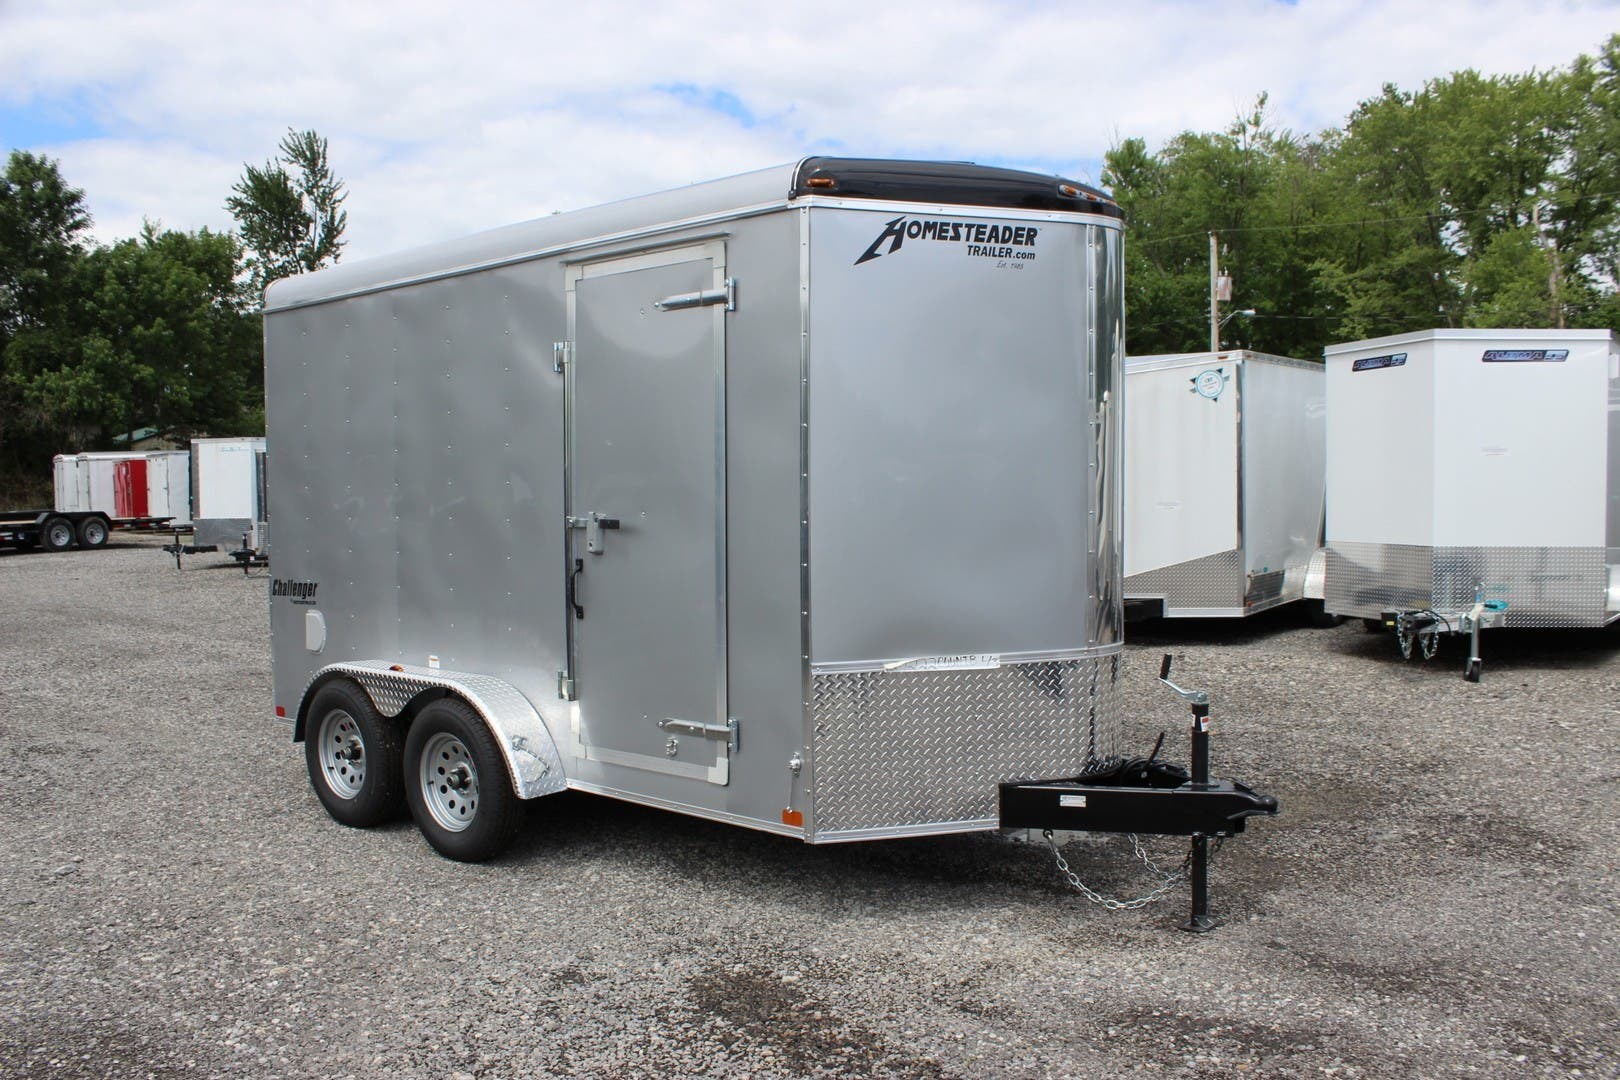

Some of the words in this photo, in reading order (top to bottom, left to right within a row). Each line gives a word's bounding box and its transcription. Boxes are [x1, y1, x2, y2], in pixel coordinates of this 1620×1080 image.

[854, 216, 1038, 266] HOMESTEADER
[967, 245, 1036, 260] TRAILER.com
[272, 579, 318, 600] Challenger
